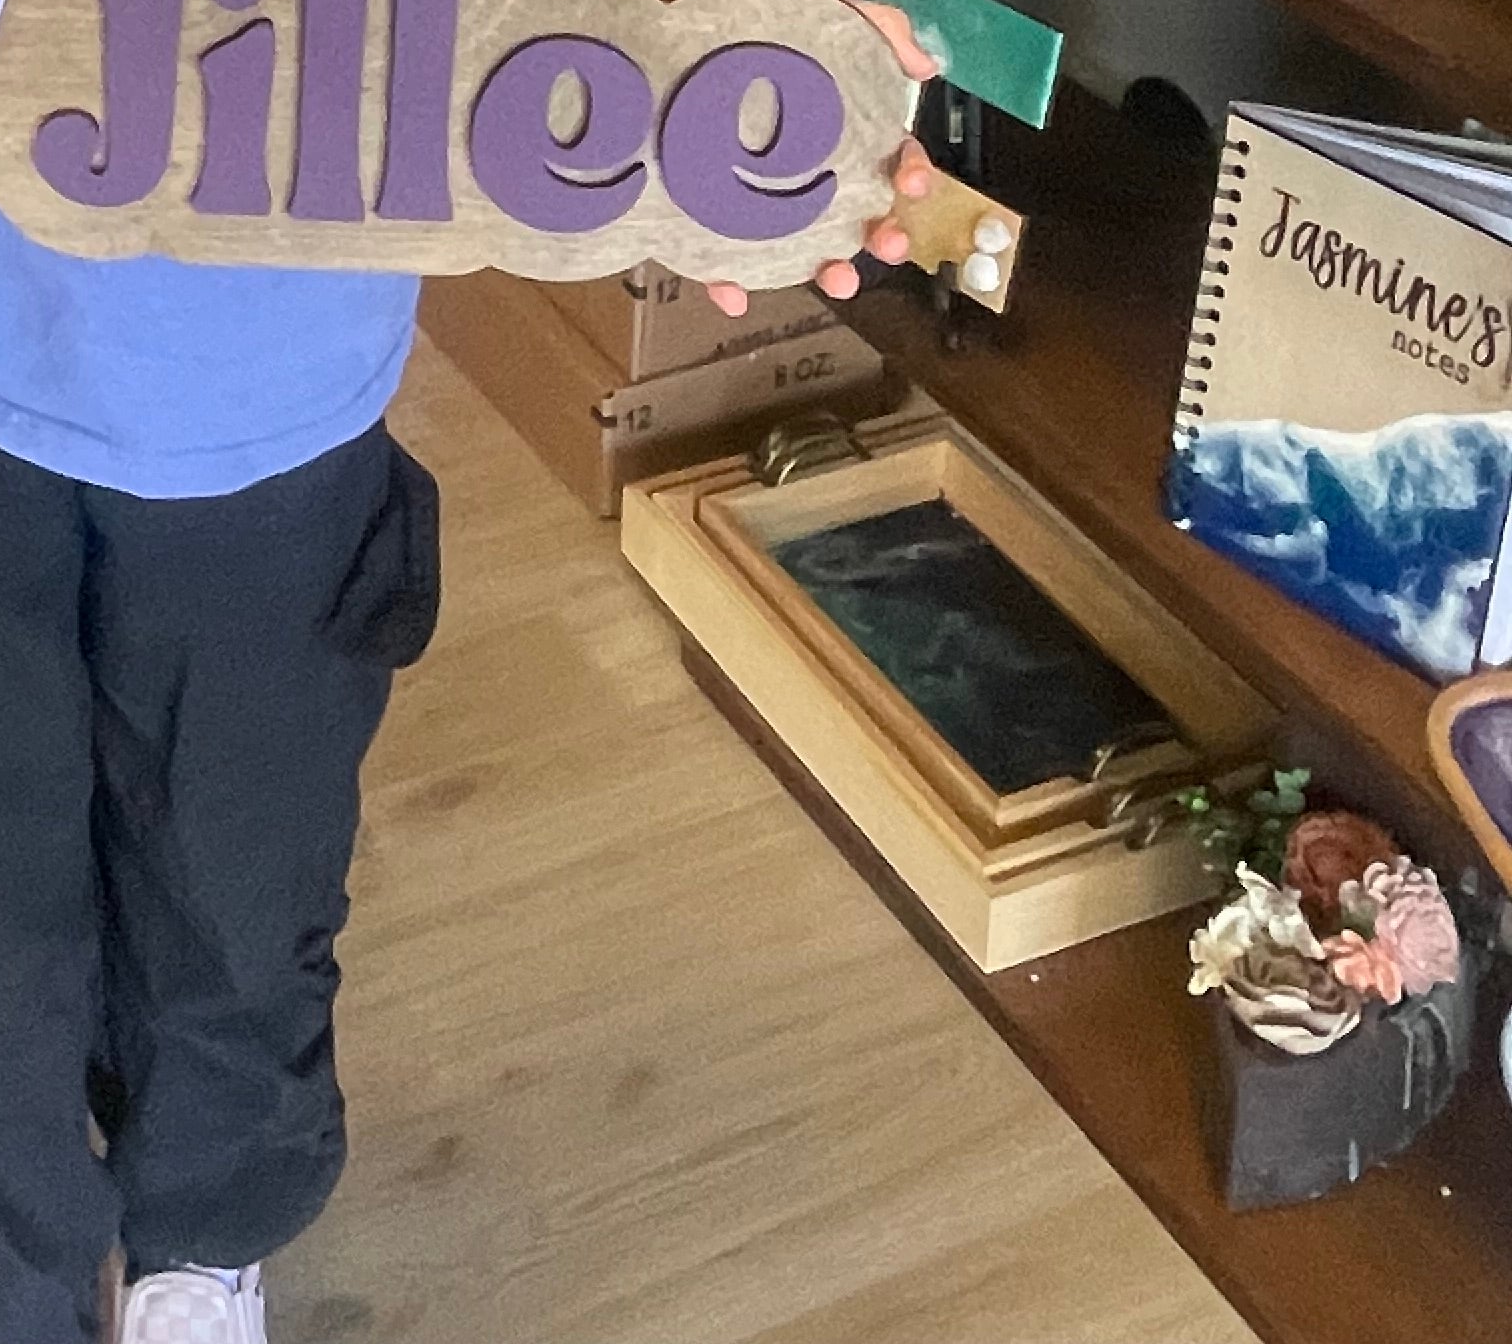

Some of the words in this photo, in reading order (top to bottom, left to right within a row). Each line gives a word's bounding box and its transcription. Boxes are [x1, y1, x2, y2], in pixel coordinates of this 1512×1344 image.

[1259, 186, 1508, 368] Jasmine's
[1390, 328, 1471, 385] notes
[626, 404, 653, 433] 12
